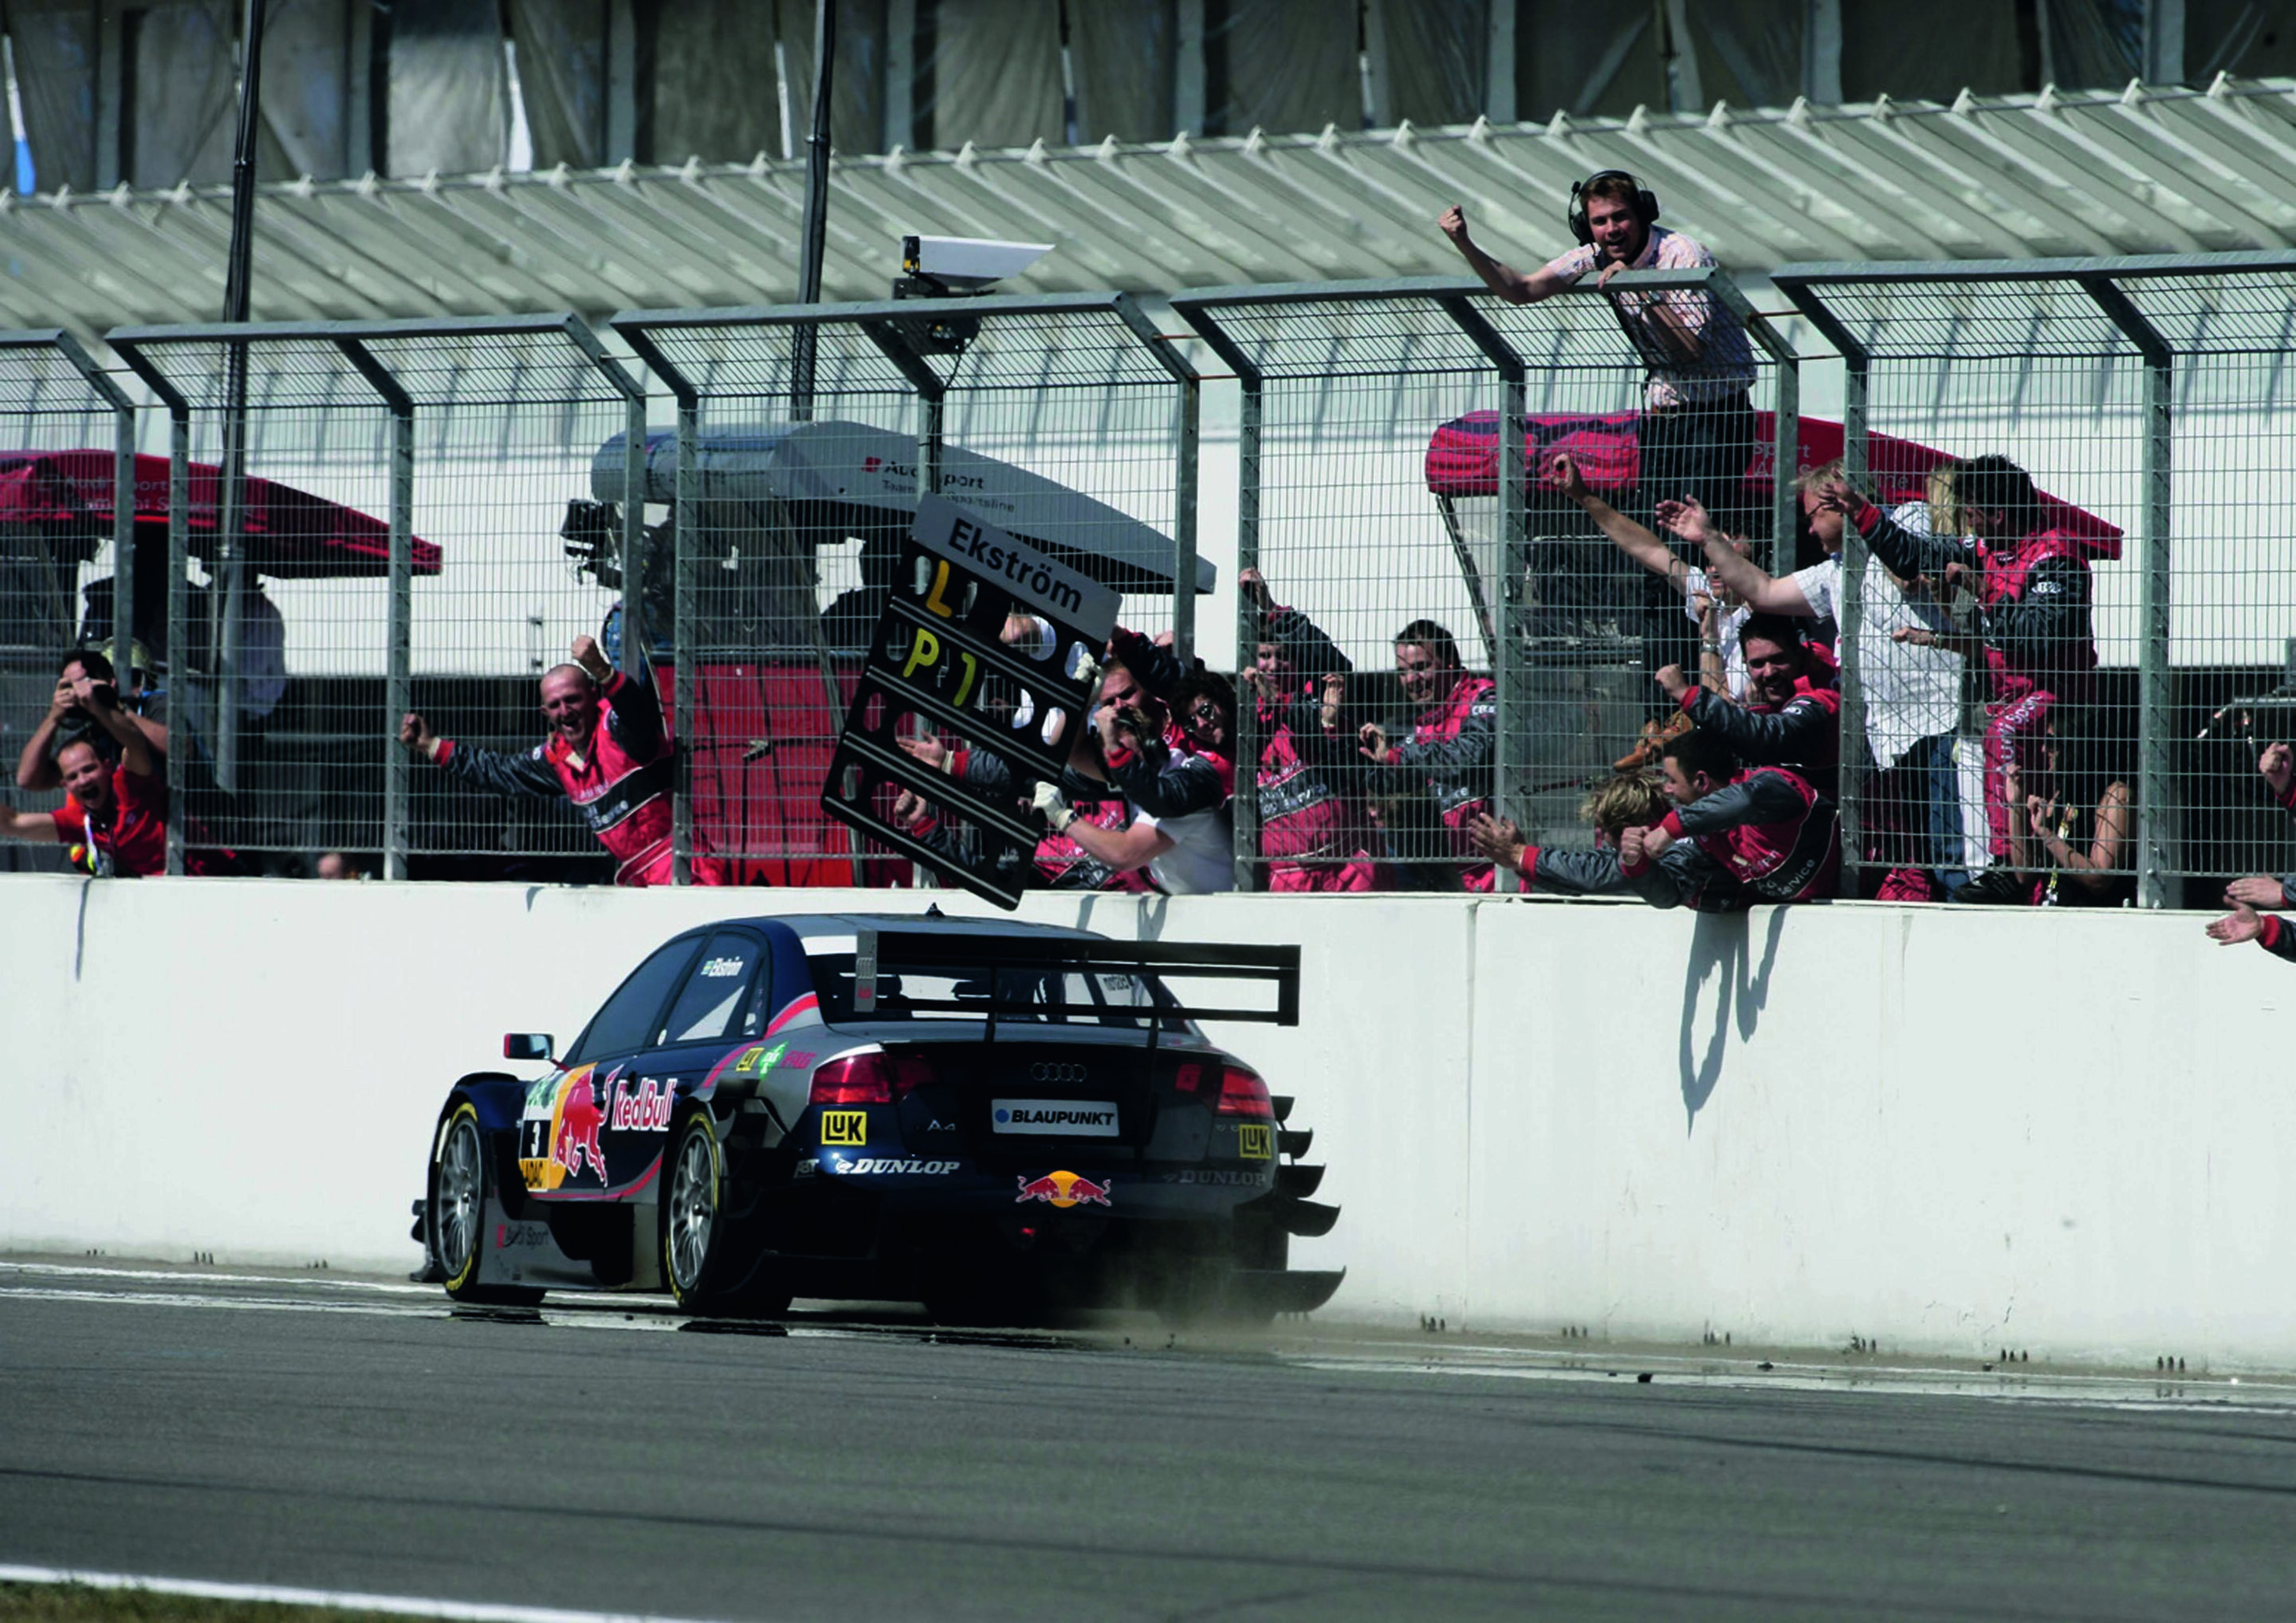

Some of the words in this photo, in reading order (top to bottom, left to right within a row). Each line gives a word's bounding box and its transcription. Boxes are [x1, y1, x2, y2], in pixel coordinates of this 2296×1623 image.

[944, 474, 985, 489] port
[948, 517, 1082, 613] Ekström
[926, 560, 952, 618] L
[611, 1078, 648, 1131] Red
[641, 1079, 678, 1132] Bull
[1011, 1109, 1115, 1126] BLAUPUNKT
[530, 1121, 541, 1157] 3
[849, 1158, 961, 1174] DUNLOP
[1178, 1169, 1268, 1187] DUNLOP
